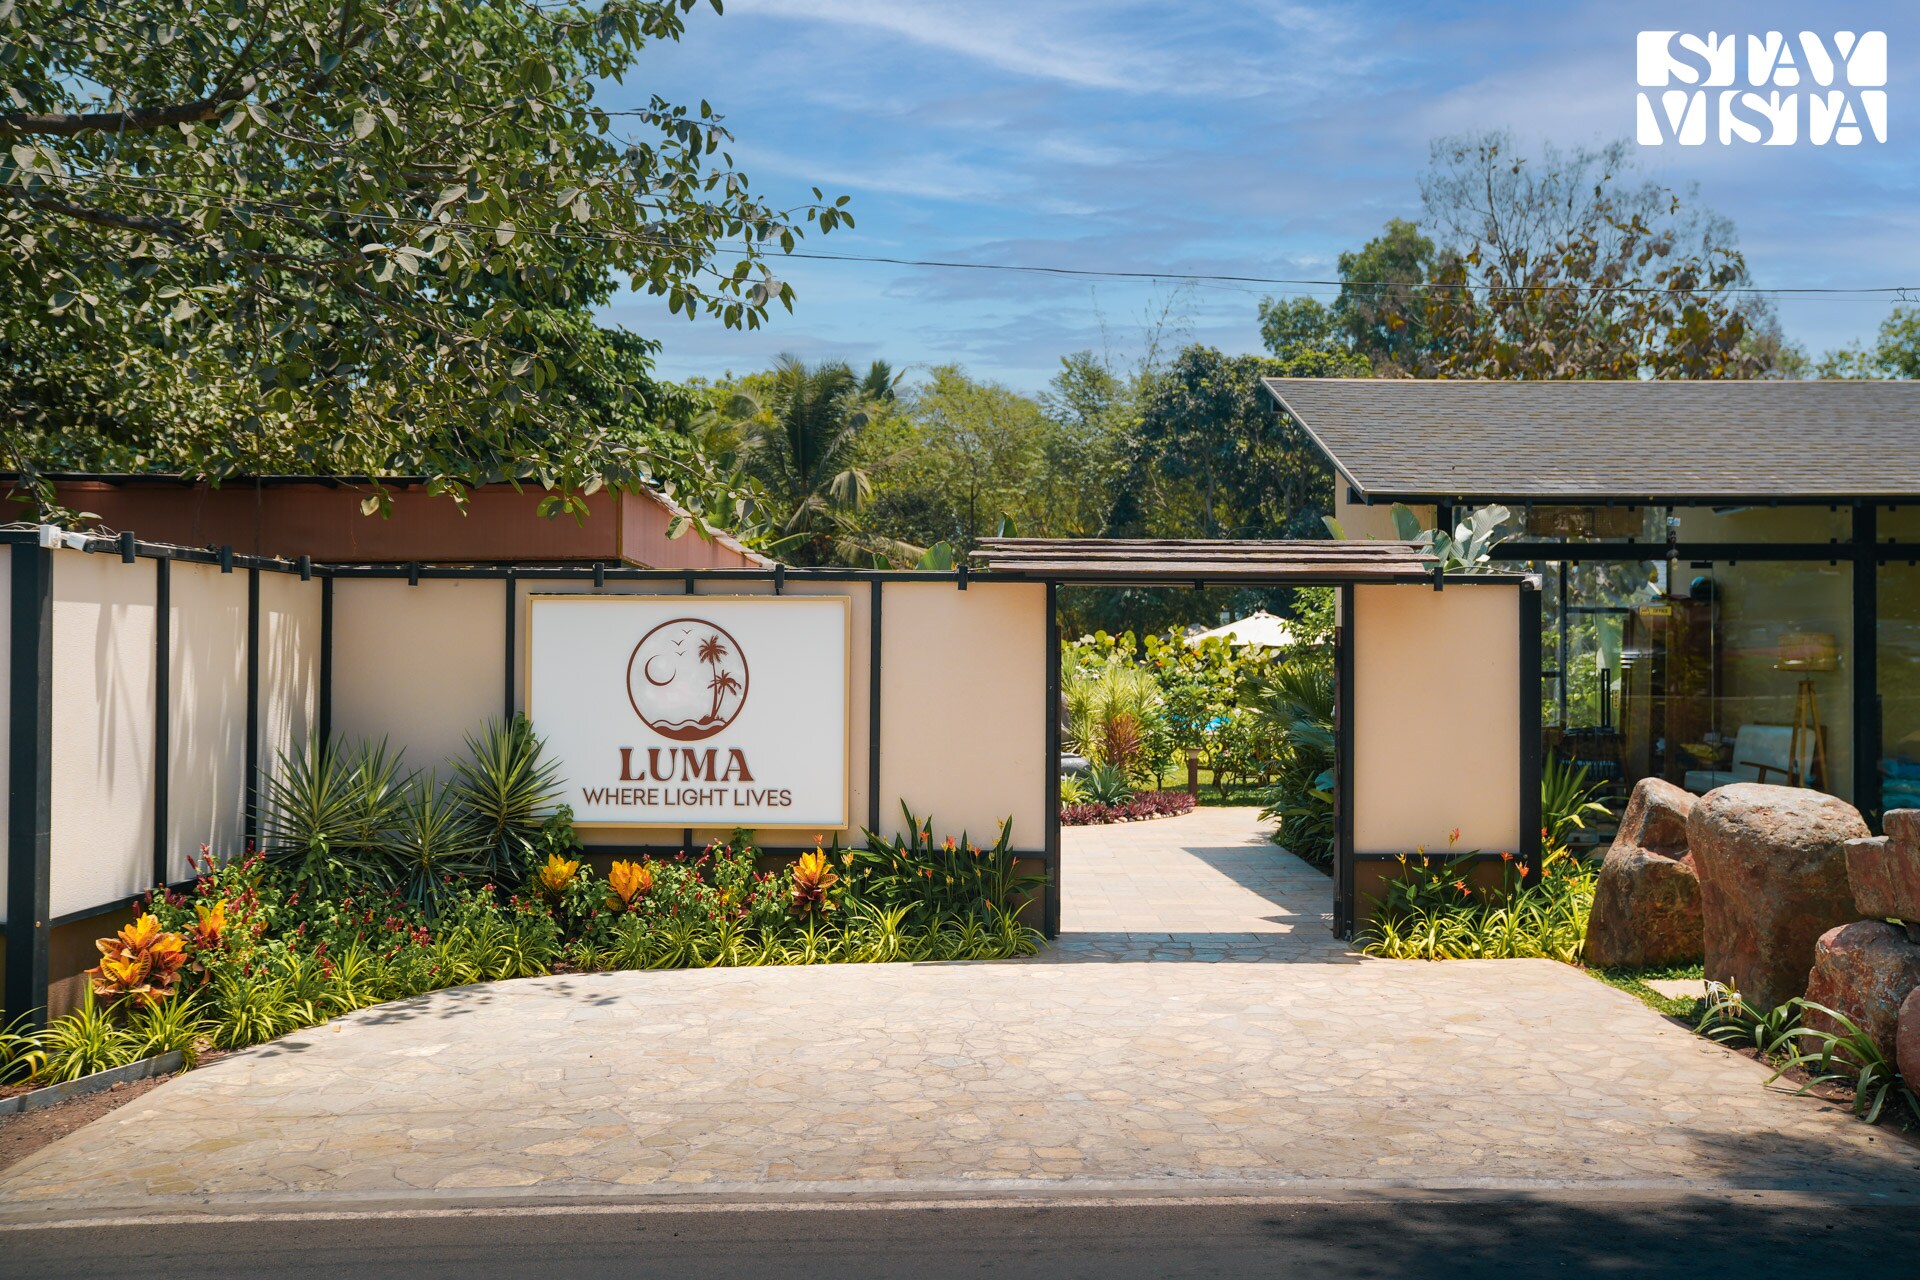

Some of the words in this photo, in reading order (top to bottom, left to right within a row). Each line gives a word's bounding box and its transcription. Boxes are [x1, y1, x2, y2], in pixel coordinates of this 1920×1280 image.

[619, 747, 754, 782] LUMA
[582, 787, 659, 805] WHERE
[664, 788, 728, 806] LIGHT
[733, 789, 792, 807] LIVES
